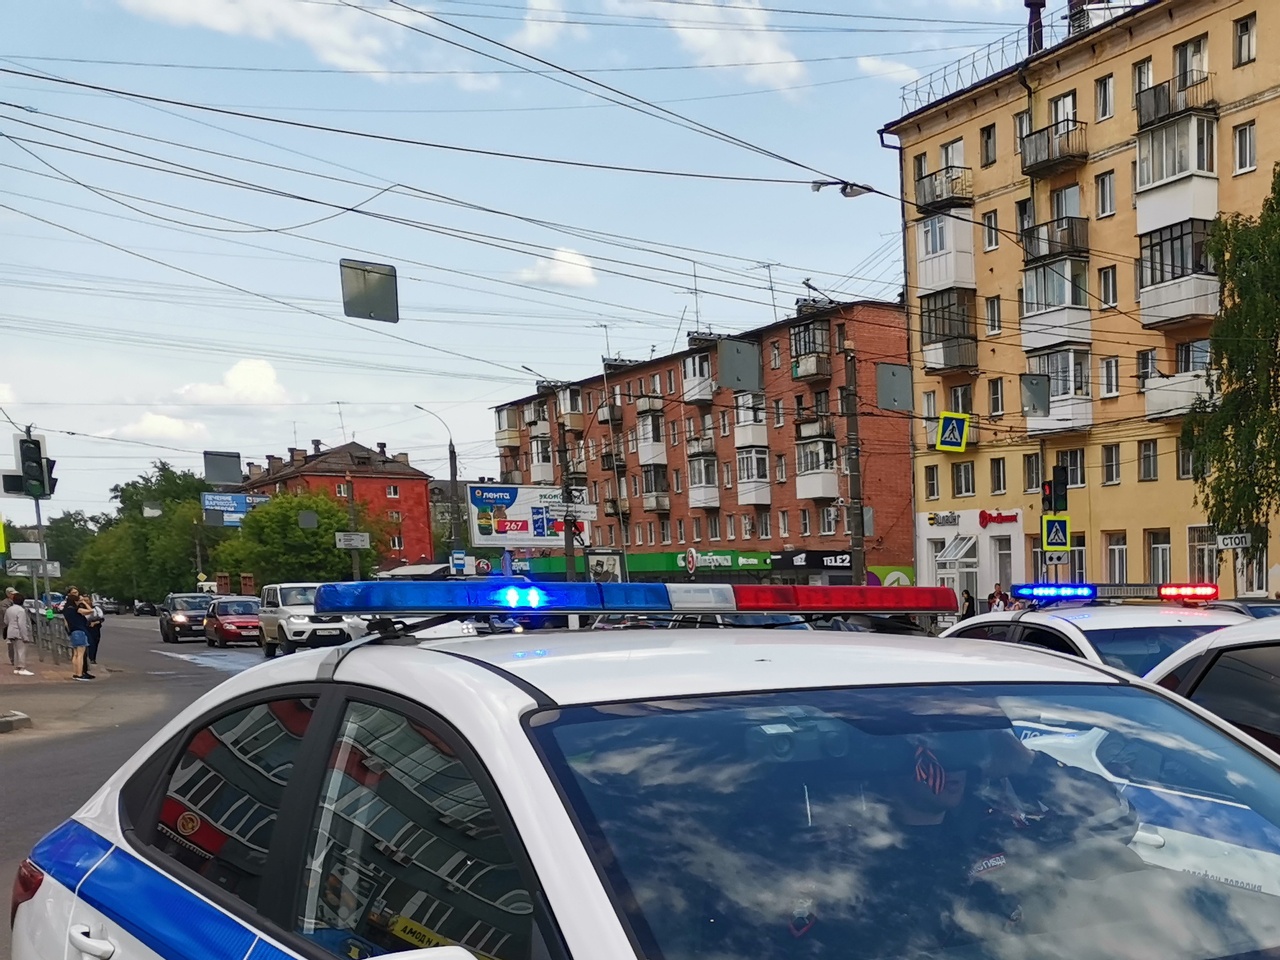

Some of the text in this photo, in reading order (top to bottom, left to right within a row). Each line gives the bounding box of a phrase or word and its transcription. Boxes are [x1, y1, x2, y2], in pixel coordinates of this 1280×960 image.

[504, 522, 522, 530] 267
[1222, 535, 1247, 547] СТОП
[822, 554, 850, 567] TELE2
